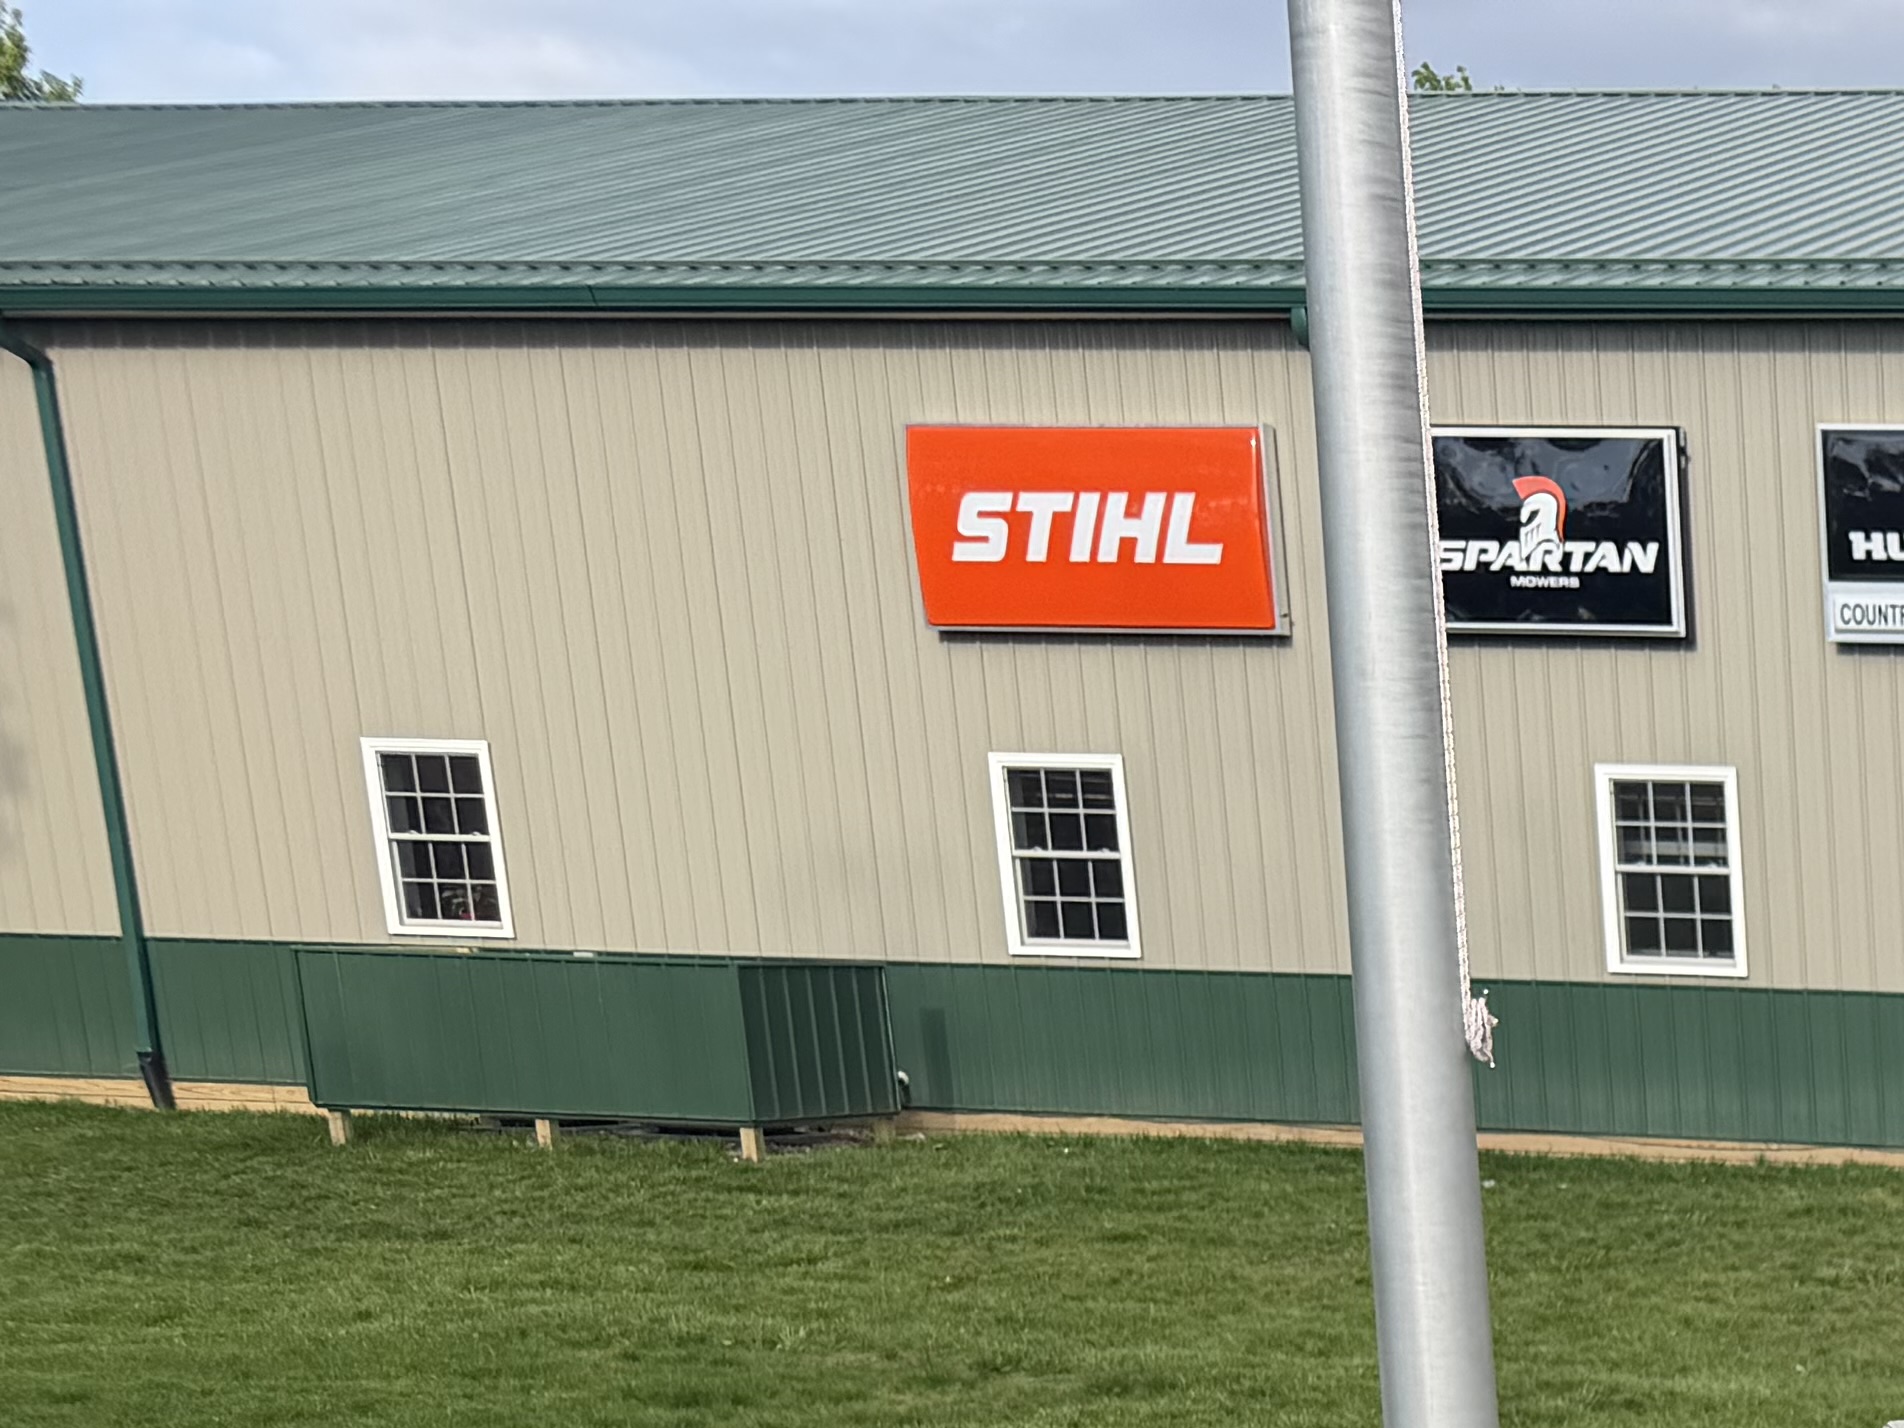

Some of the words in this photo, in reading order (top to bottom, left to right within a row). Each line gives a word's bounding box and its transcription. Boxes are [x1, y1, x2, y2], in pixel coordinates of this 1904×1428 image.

[952, 492, 1223, 564] STIHL
[1440, 540, 1659, 573] SPARTAN
[1510, 576, 1580, 588] MOWERS
